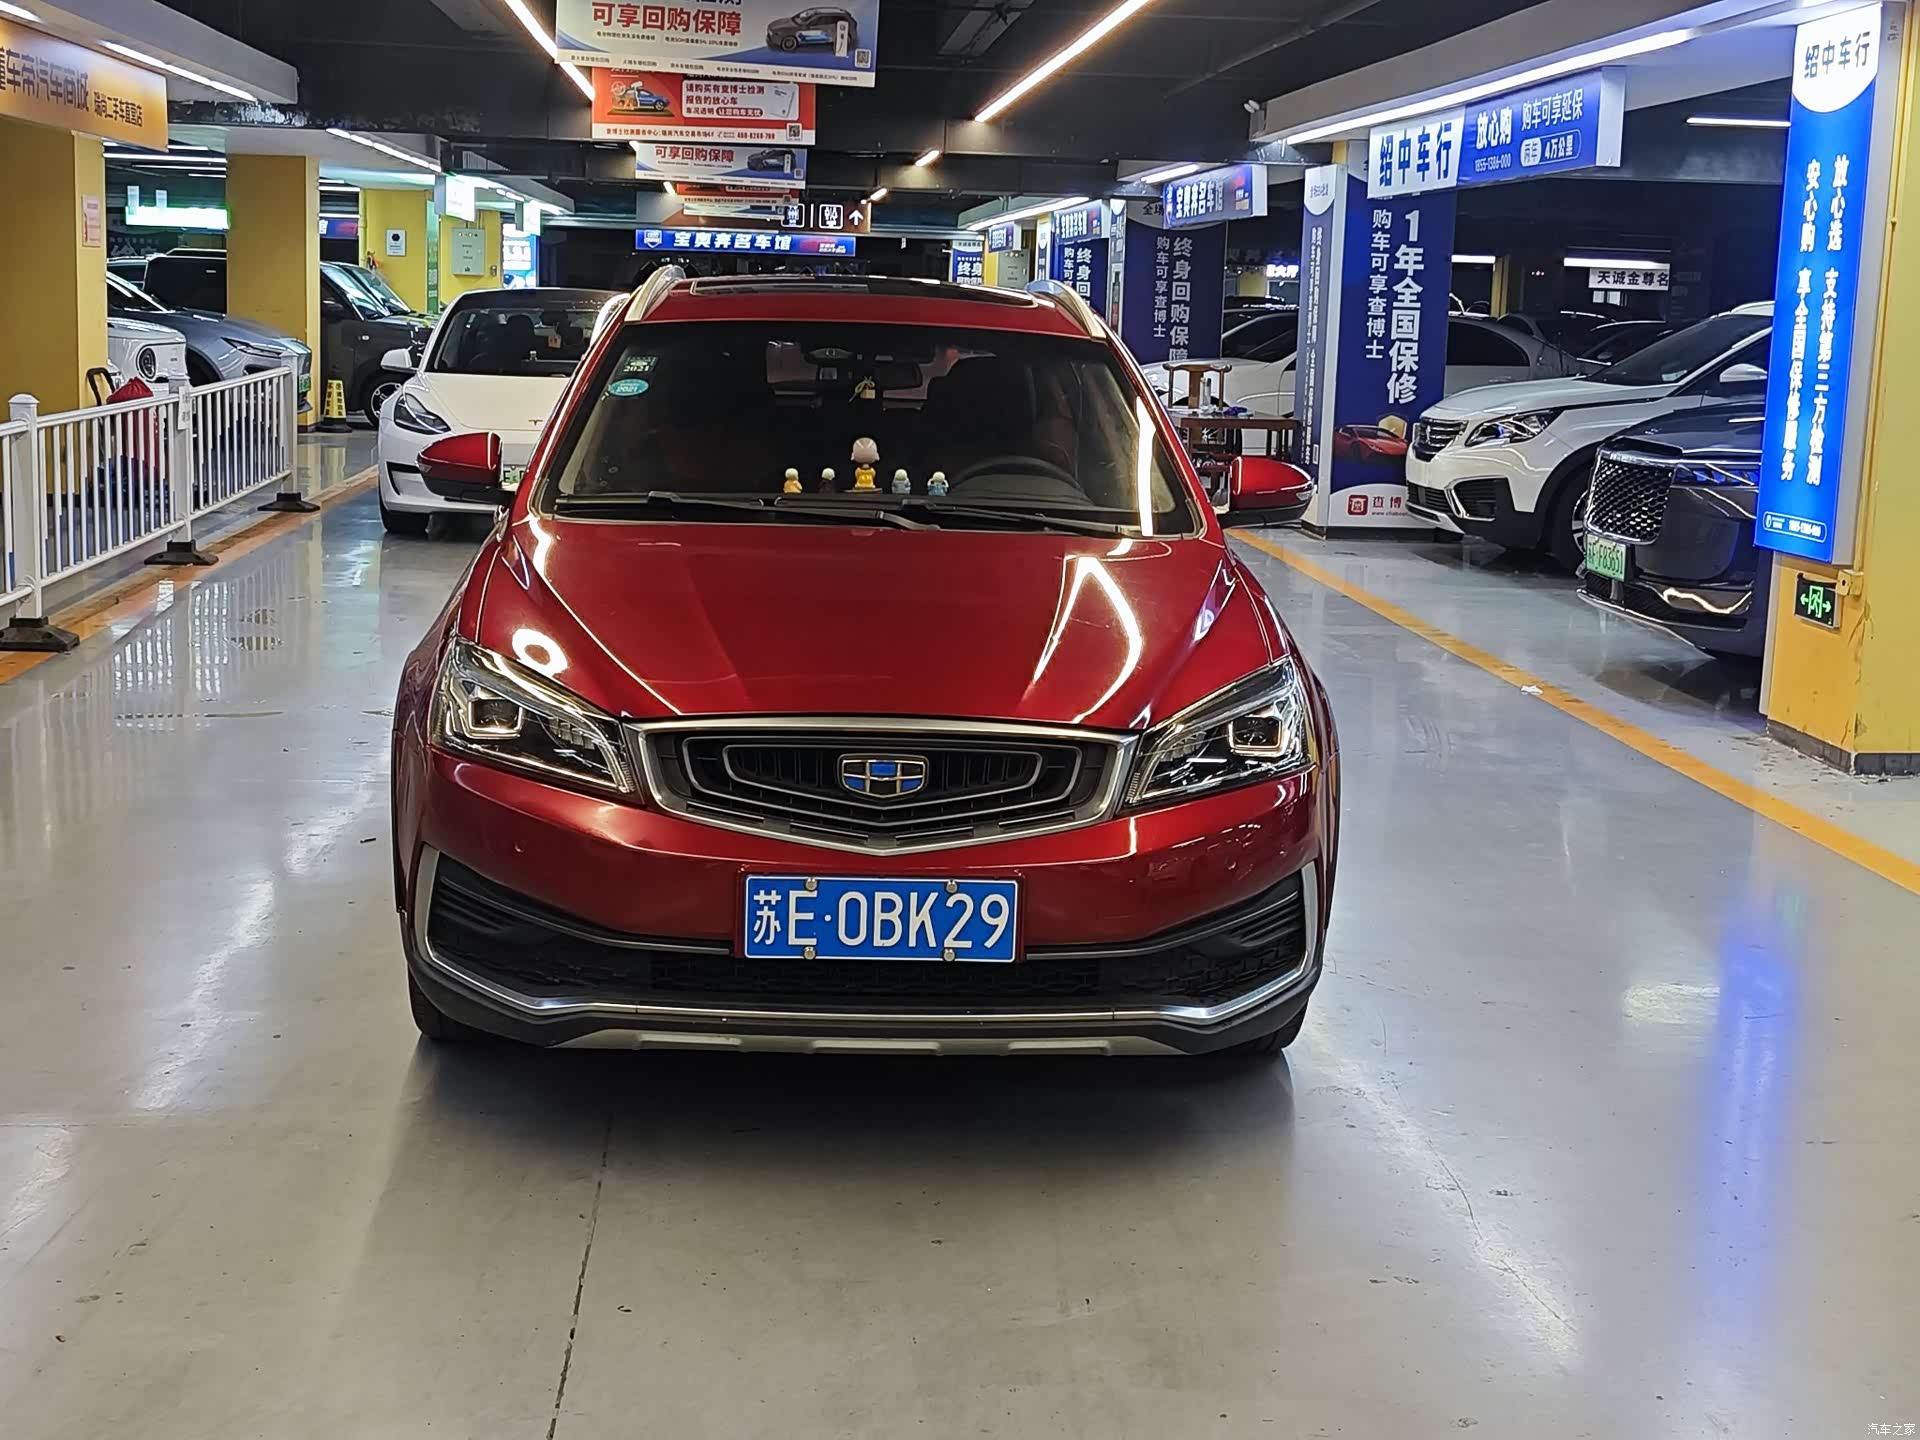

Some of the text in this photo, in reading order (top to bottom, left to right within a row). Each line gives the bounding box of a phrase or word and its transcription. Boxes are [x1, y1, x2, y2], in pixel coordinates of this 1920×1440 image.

[591, 2, 742, 36] 可享回购保障
[1804, 31, 1871, 78] 绍中车行
[685, 95, 738, 105] 报告的放心车
[1521, 88, 1584, 132] 购车可享延保
[655, 145, 734, 163] 可享回购保障
[1379, 121, 1453, 187] 绍中车行
[1476, 106, 1513, 150] 放心购
[1545, 135, 1574, 161] 4万公里
[673, 231, 793, 251] 宝奥奔名车馆
[1153, 236, 1170, 338] 购车可享查博士
[1168, 237, 1193, 361] 终身回购保障
[1365, 209, 1392, 359] 购车可享查博士
[1387, 210, 1425, 404] 1年全国保修
[1780, 158, 1821, 481] 安心购 享全国保修服务
[1806, 154, 1850, 486] 放心选 支持第三方检测
[753, 889, 1010, 949] 苏E·0BK29
